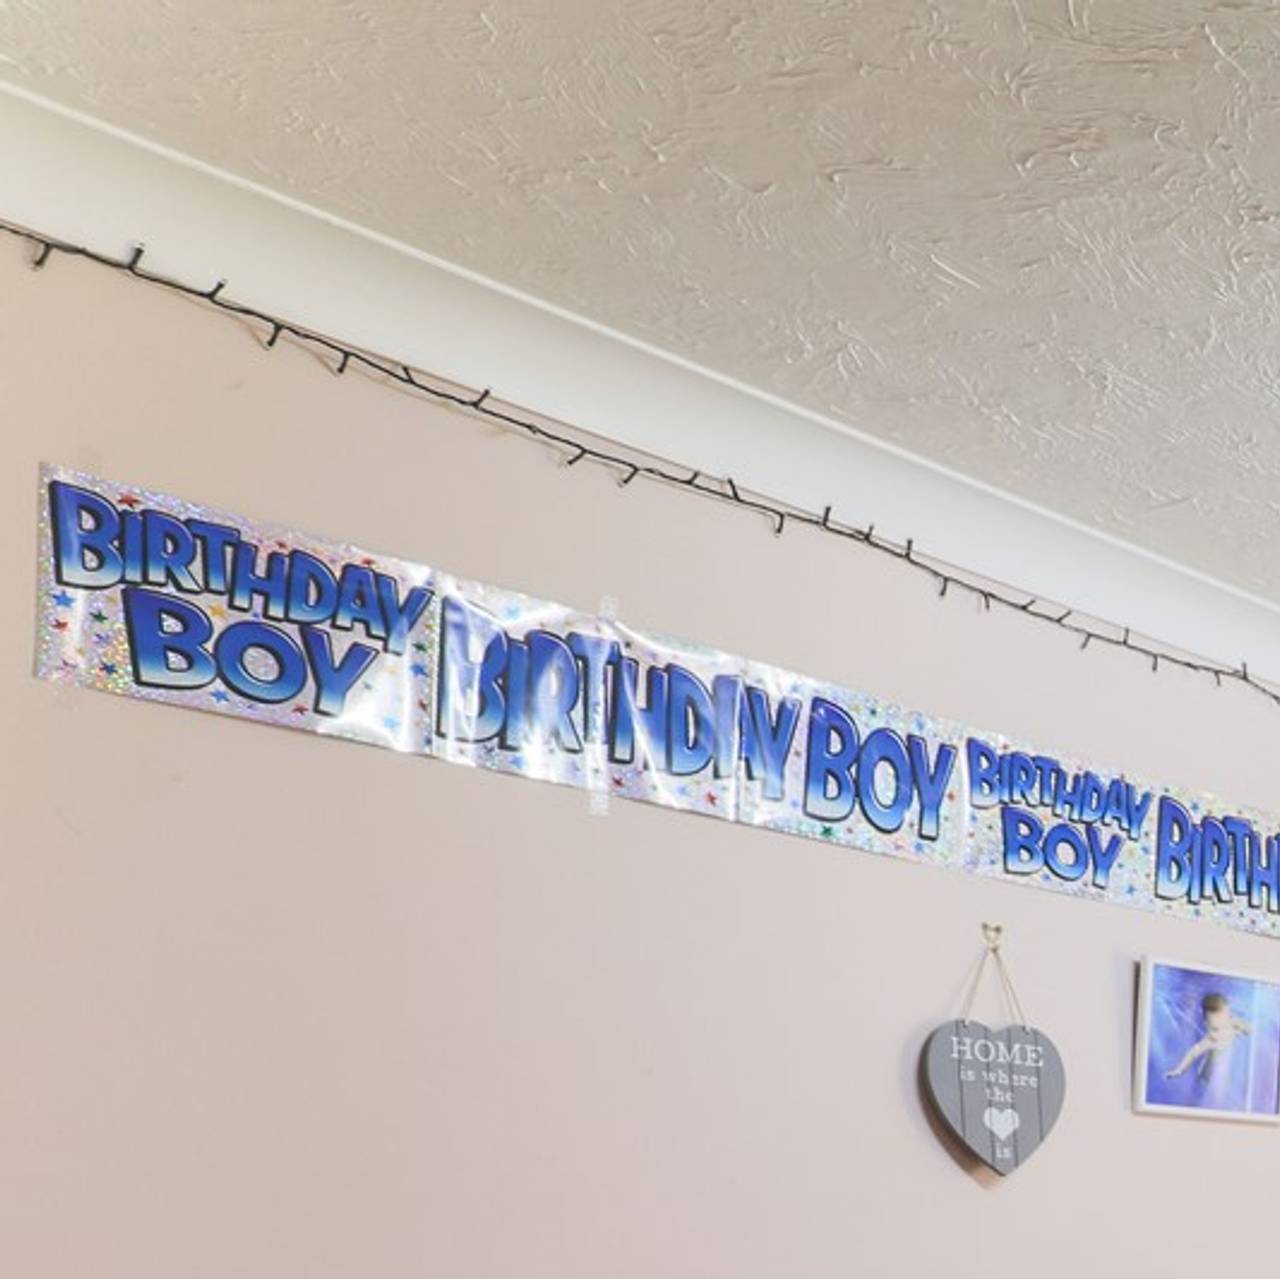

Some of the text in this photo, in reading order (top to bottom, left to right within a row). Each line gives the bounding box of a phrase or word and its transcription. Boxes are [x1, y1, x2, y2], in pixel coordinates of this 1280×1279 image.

[48, 479, 433, 655] BIRTHDAY
[122, 586, 380, 717] BOY
[802, 696, 957, 841] BOY
[965, 736, 1153, 841] BIRTHDAY
[1001, 804, 1125, 888] BOY
[951, 1036, 1044, 1068] HOME
[960, 1065, 1038, 1089] is where
[986, 1086, 1015, 1103] the
